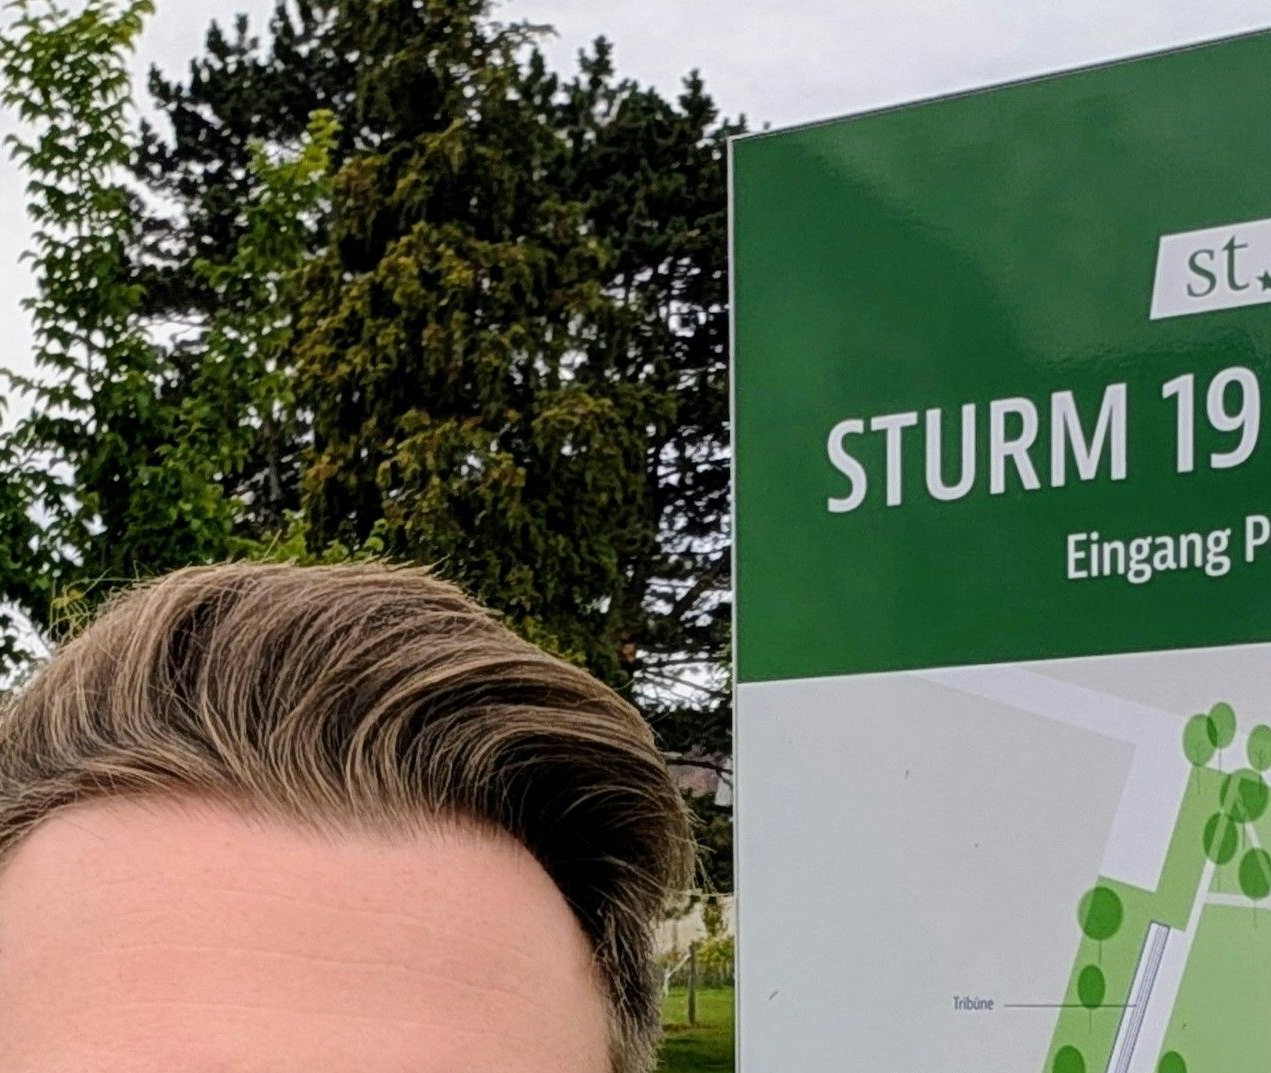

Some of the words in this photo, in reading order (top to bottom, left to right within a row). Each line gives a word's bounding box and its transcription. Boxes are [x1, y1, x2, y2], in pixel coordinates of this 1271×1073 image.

[825, 382, 1129, 514] STURM
[1162, 367, 1262, 475] 19
[1066, 522, 1231, 584] Eingang
[953, 996, 994, 1011] Tribüne
